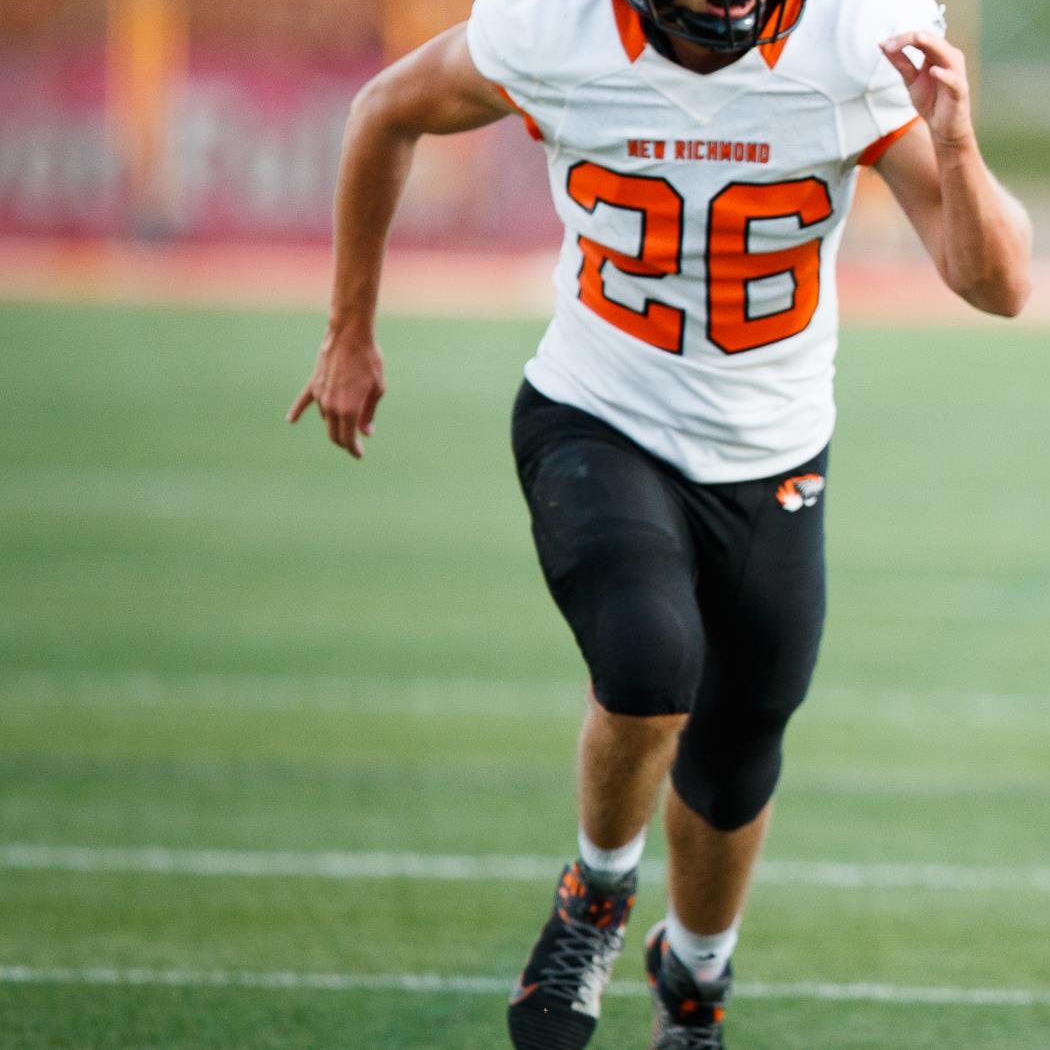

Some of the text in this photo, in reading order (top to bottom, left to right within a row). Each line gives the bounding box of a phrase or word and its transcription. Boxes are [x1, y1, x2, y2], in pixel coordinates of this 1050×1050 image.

[628, 140, 770, 163] NEW RICHMOND
[567, 160, 833, 355] 26
